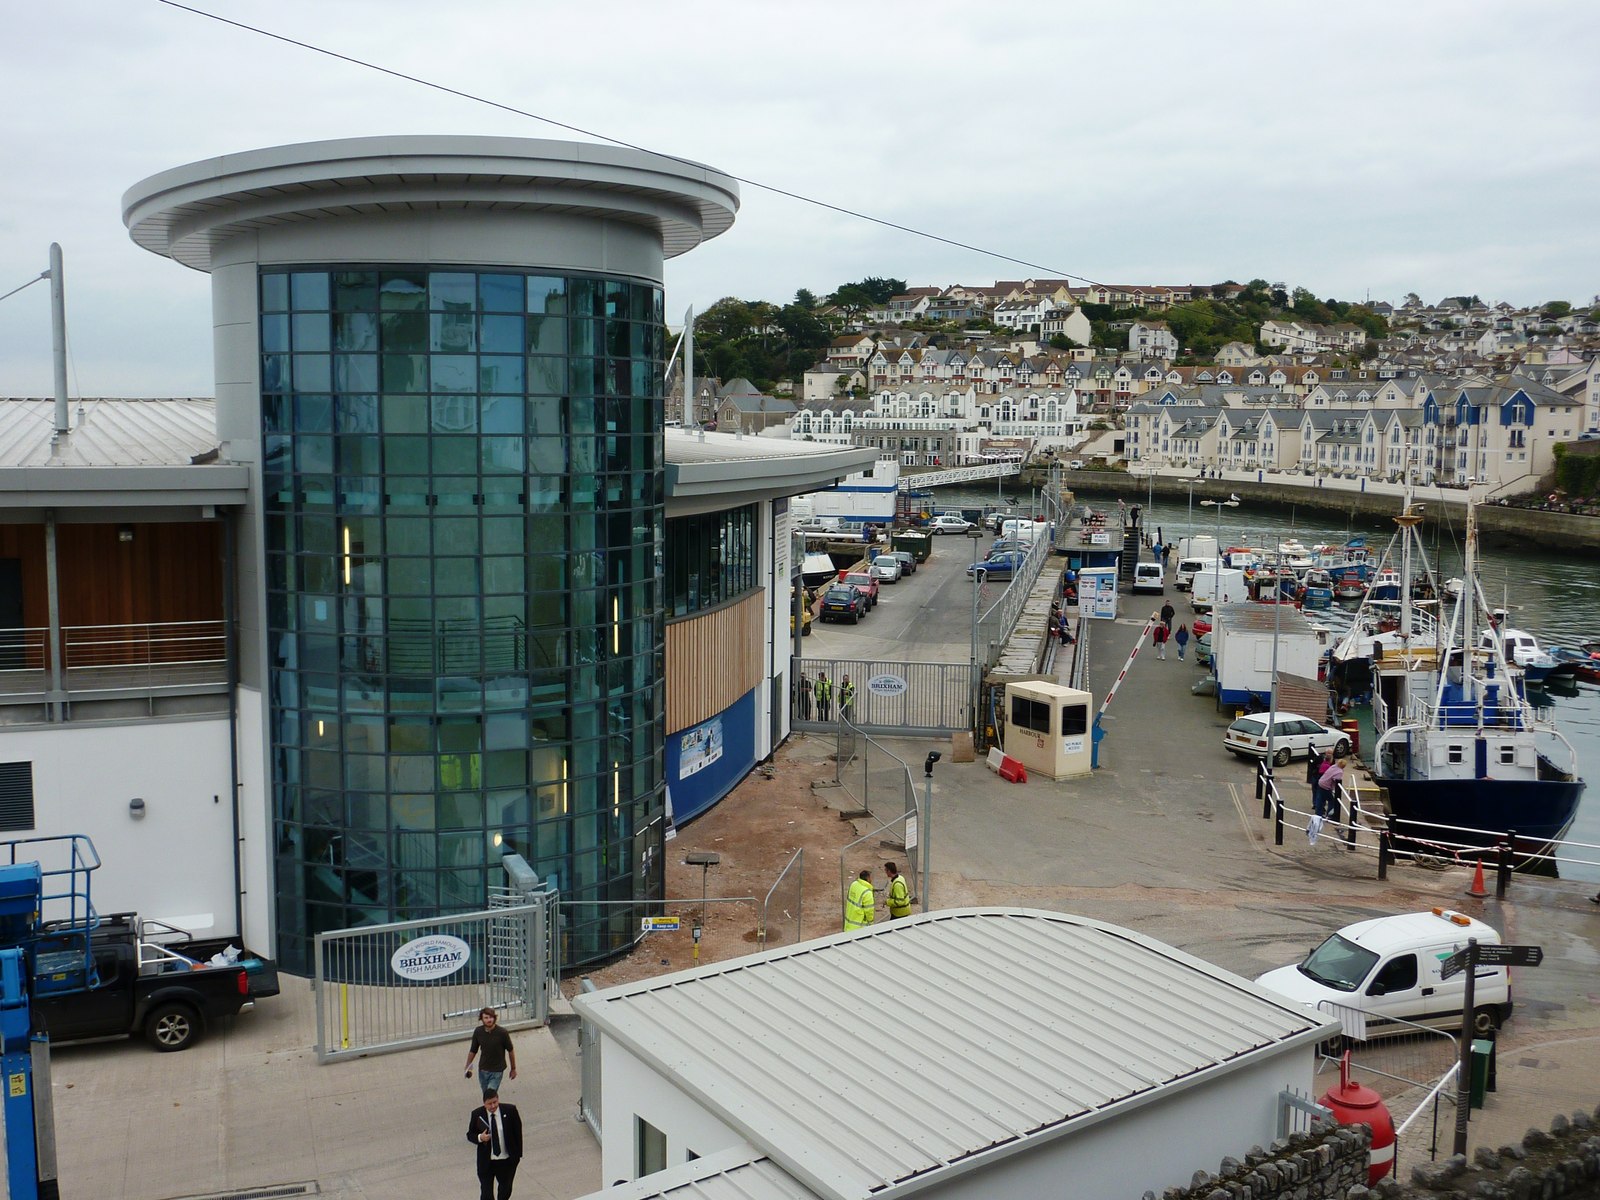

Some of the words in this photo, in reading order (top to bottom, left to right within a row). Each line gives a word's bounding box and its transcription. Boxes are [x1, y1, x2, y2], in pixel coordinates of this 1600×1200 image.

[1020, 728, 1040, 738] HARBOUR
[415, 940, 435, 949] WORLD
[435, 940, 457, 949] FAMOUS
[400, 952, 461, 968] BRIXHAM
[424, 962, 455, 971] MARKET
